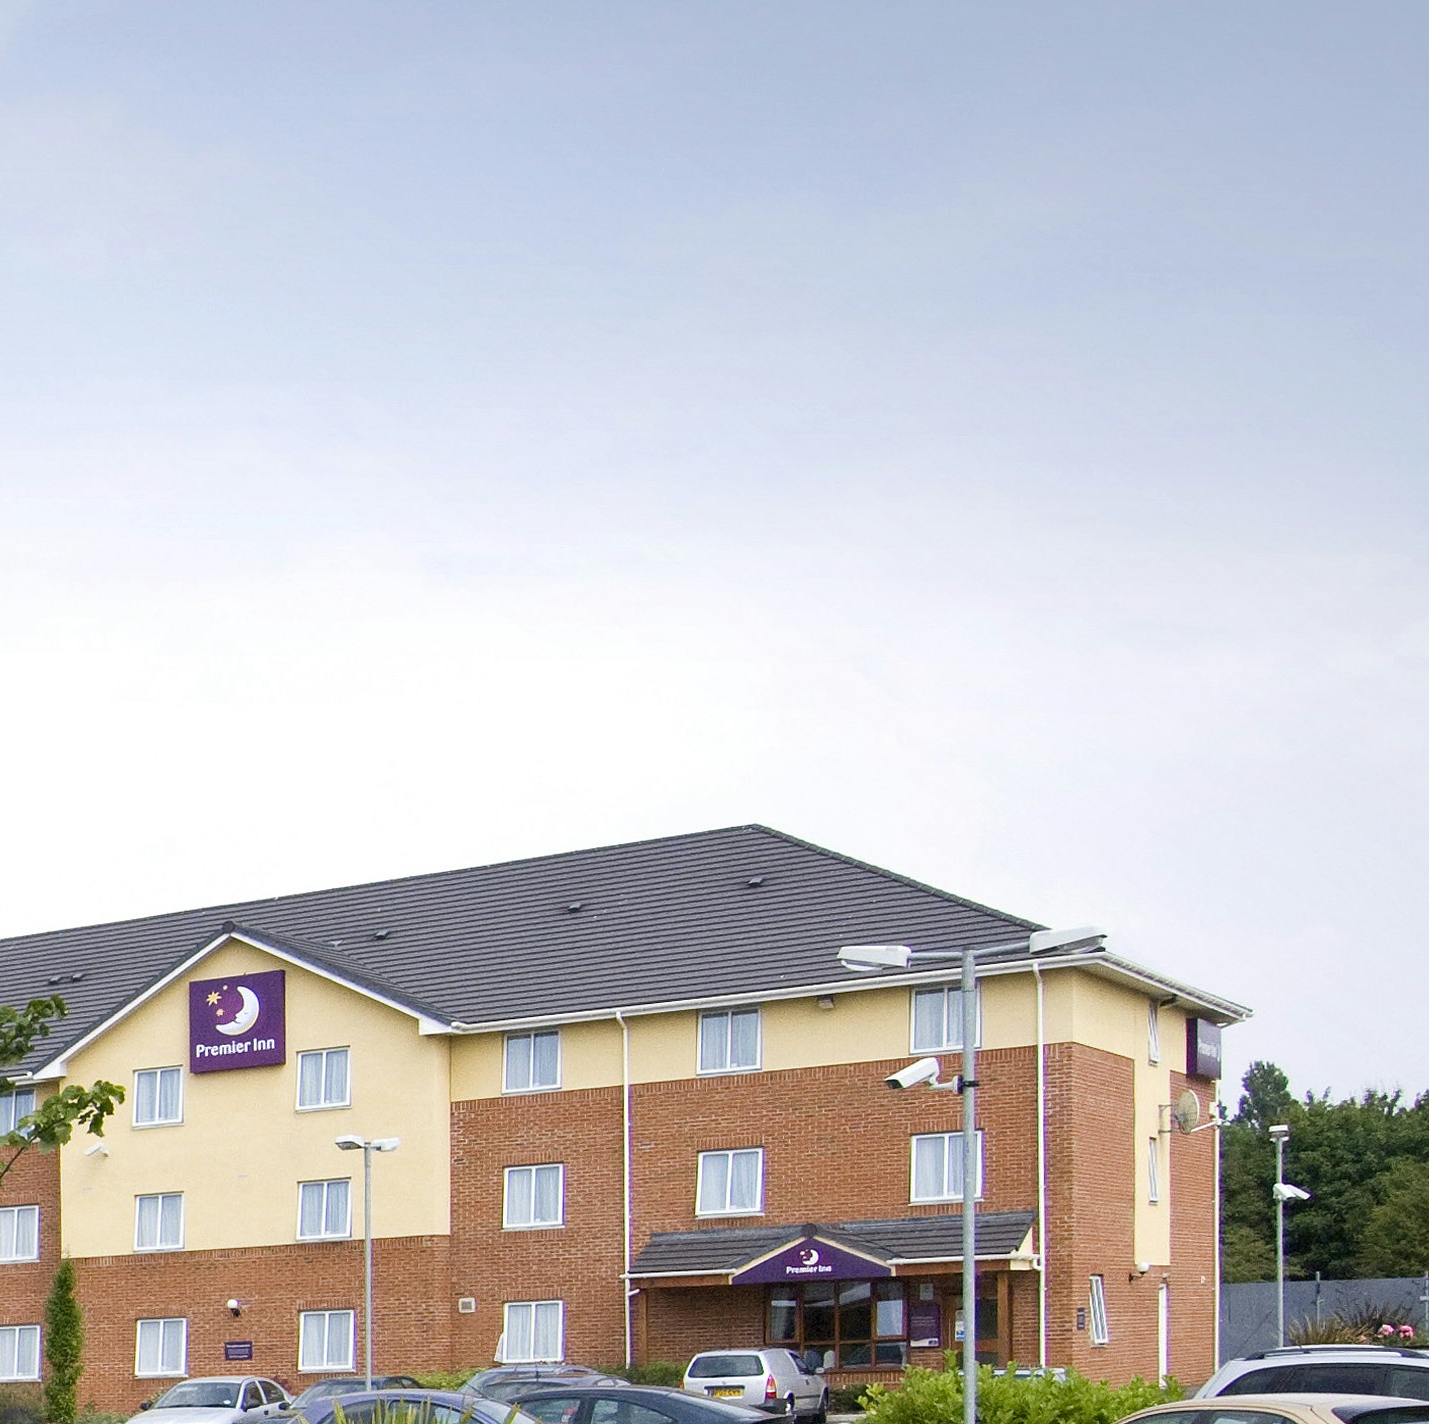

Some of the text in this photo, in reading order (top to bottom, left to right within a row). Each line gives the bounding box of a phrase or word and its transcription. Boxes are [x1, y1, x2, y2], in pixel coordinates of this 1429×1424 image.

[196, 1038, 275, 1058] Premier Inn
[786, 1265, 817, 1274] Premier
